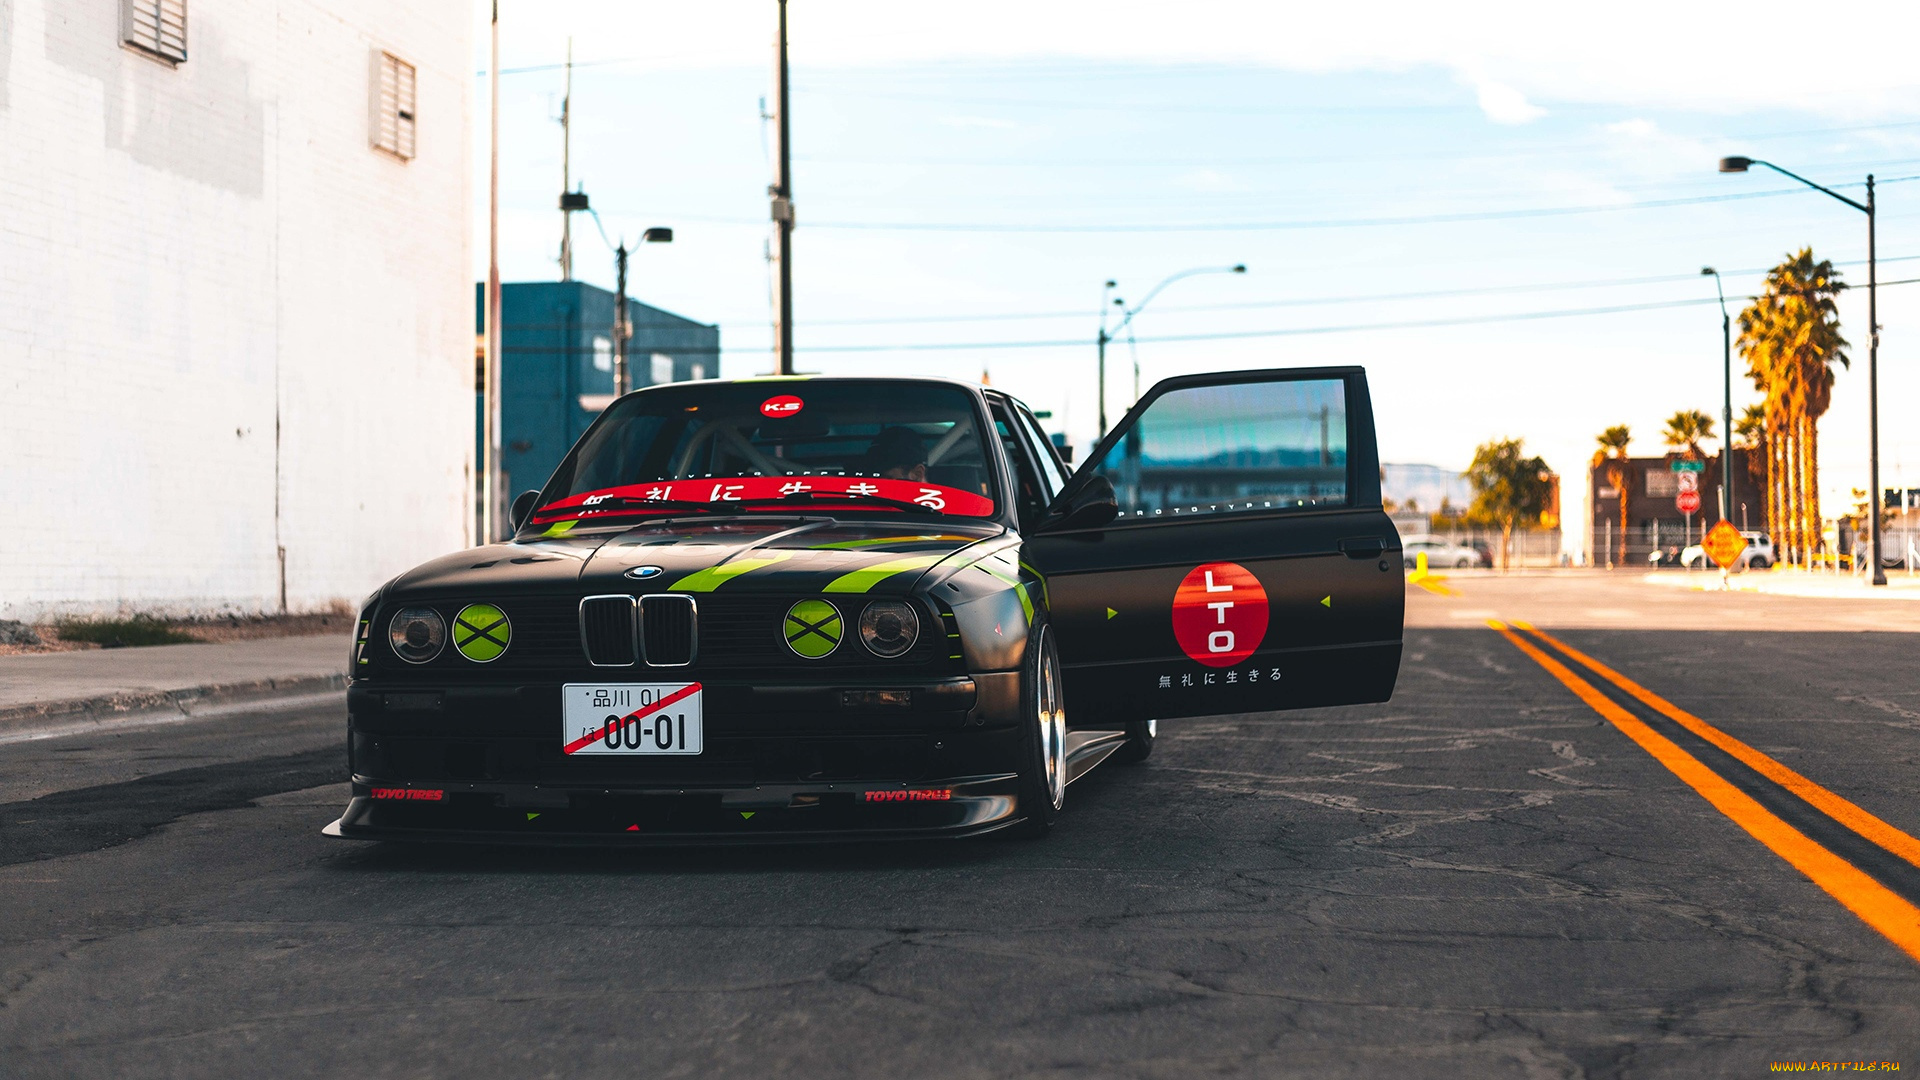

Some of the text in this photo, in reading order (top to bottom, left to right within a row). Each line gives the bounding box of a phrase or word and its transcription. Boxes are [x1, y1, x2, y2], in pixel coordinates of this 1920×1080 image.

[1117, 500, 1271, 518] PROTOTYPE
[1204, 570, 1235, 653] LTO
[1158, 667, 1282, 689] 無礼に生きる
[593, 688, 630, 708] 品川
[604, 714, 685, 750] 00-01
[371, 787, 444, 801] TOYO TIRES
[864, 788, 952, 803] TOYO TIRES
